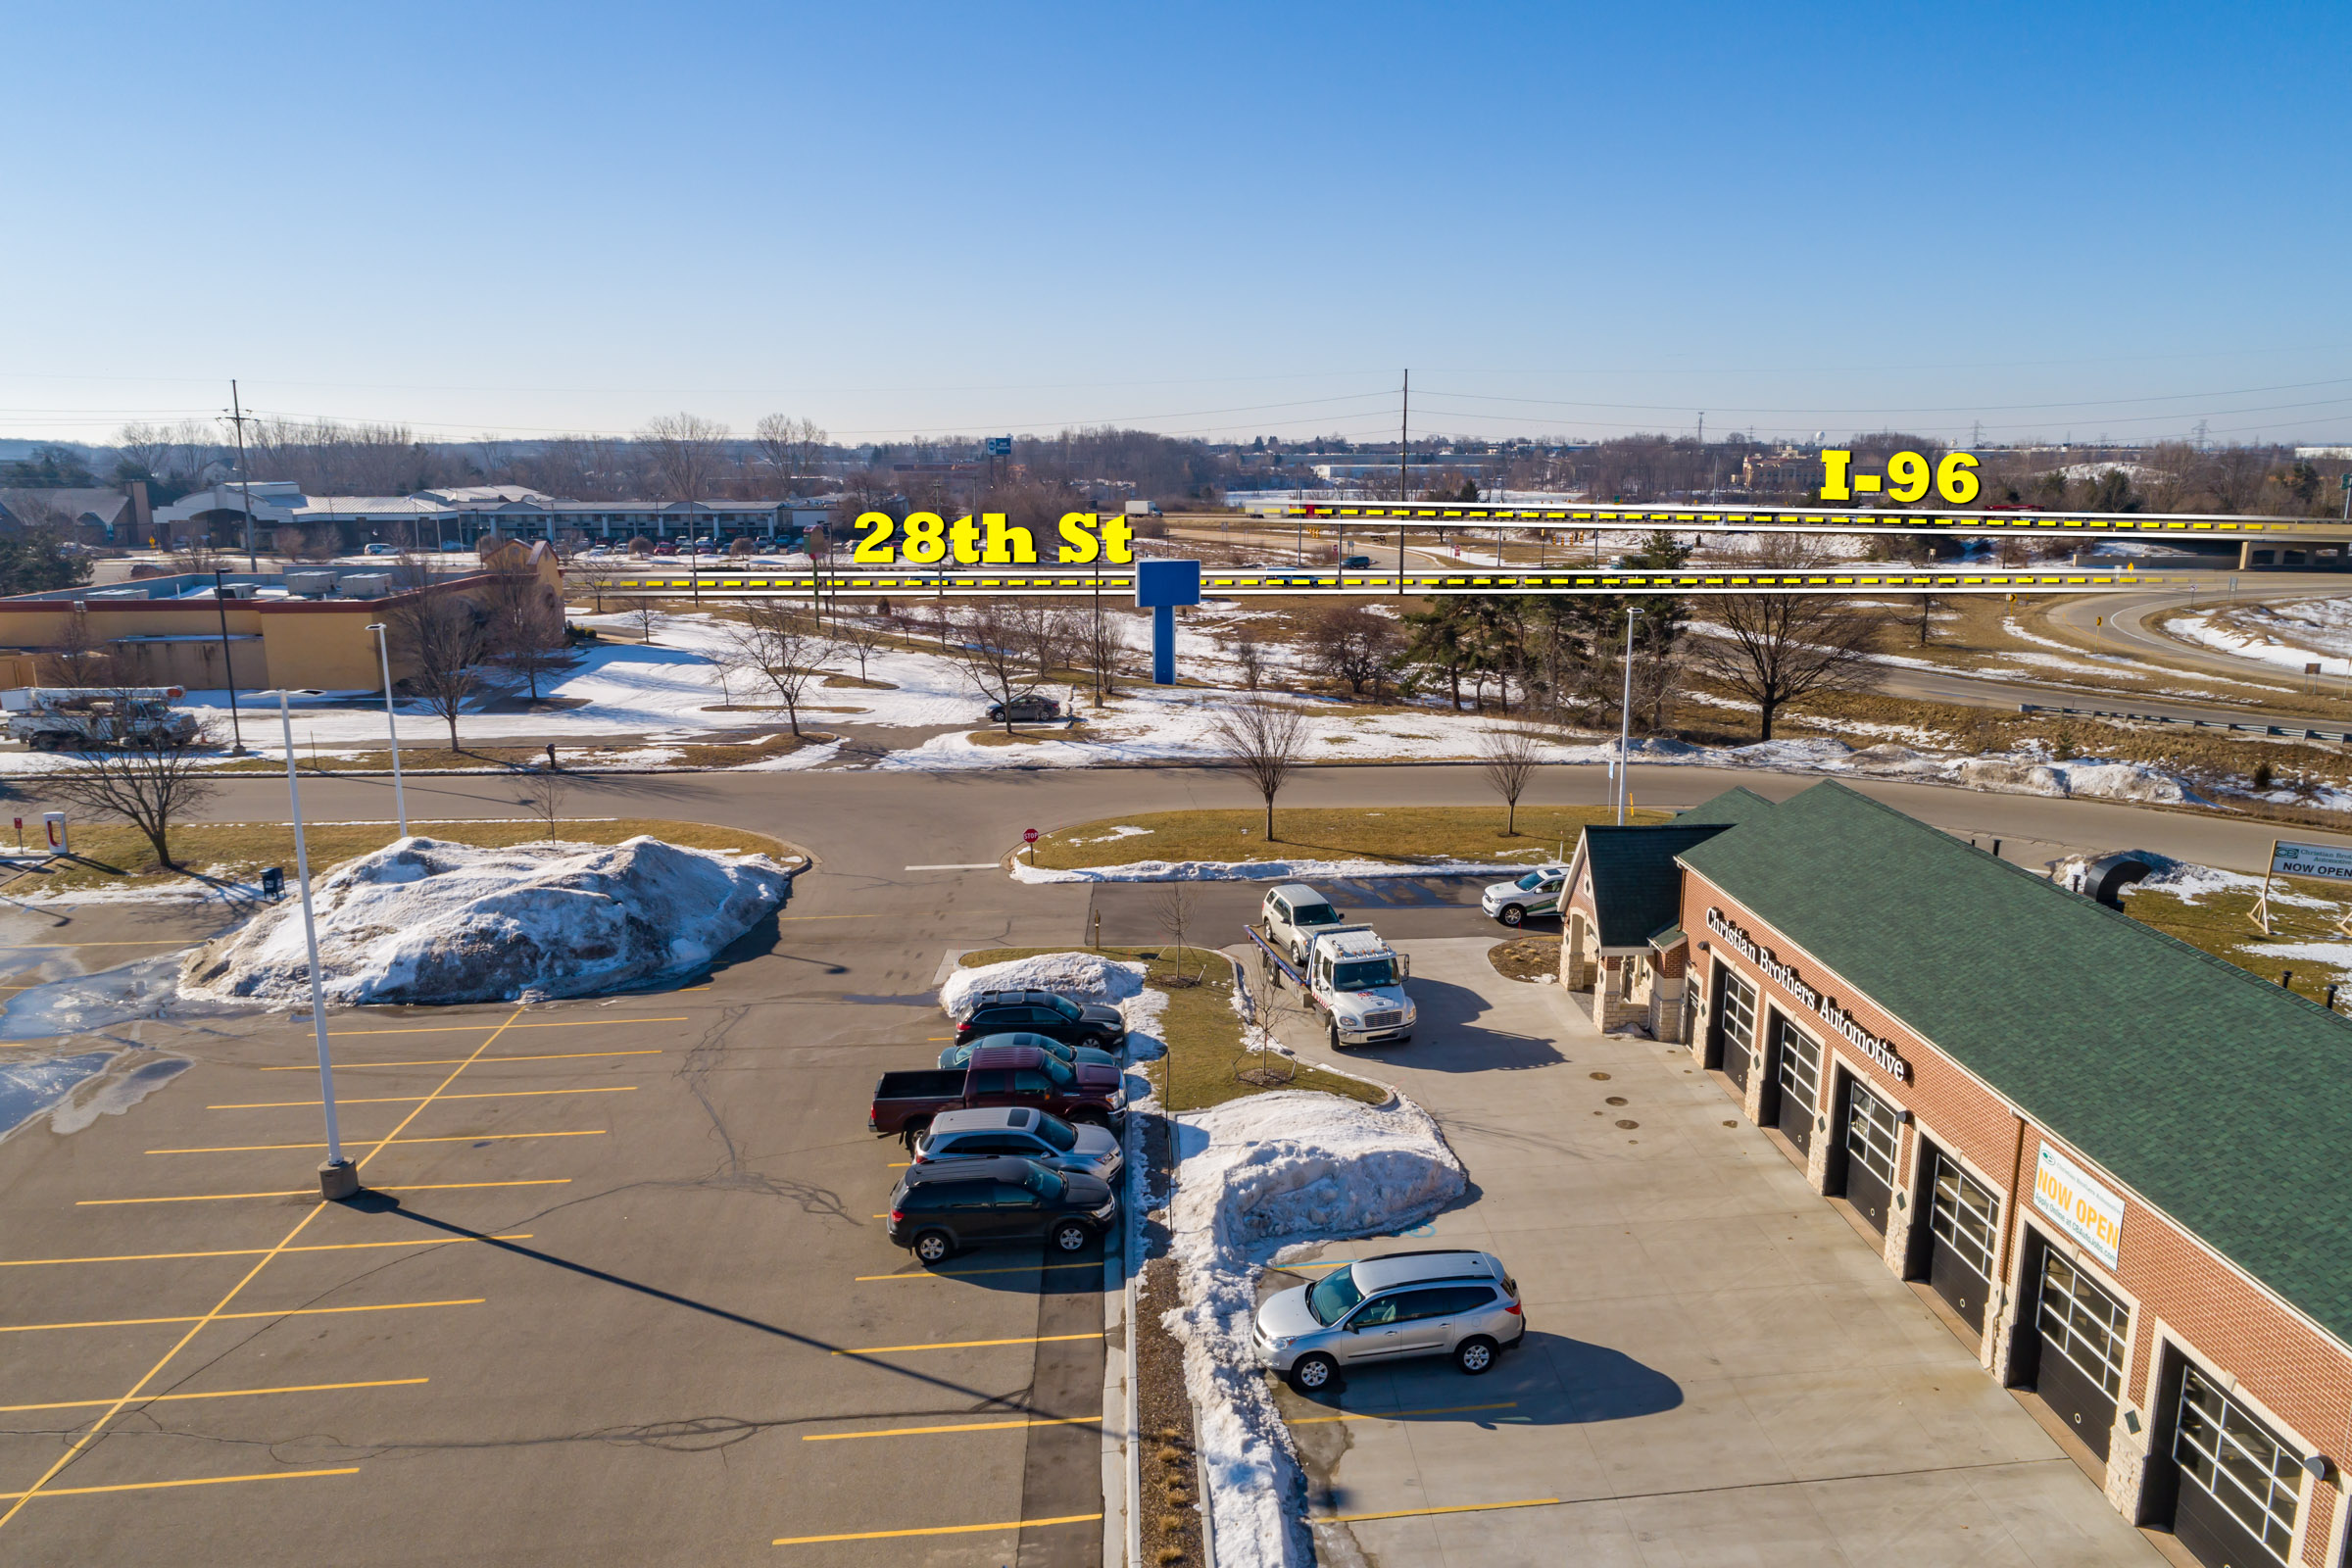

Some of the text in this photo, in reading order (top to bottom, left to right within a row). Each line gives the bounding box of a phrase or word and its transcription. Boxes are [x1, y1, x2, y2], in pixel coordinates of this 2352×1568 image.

[2283, 862, 2352, 877] NOW OPEN
[1706, 906, 1904, 1082] Christian Brothers Automotive
[2037, 1167, 2120, 1250] NOW OPEN
